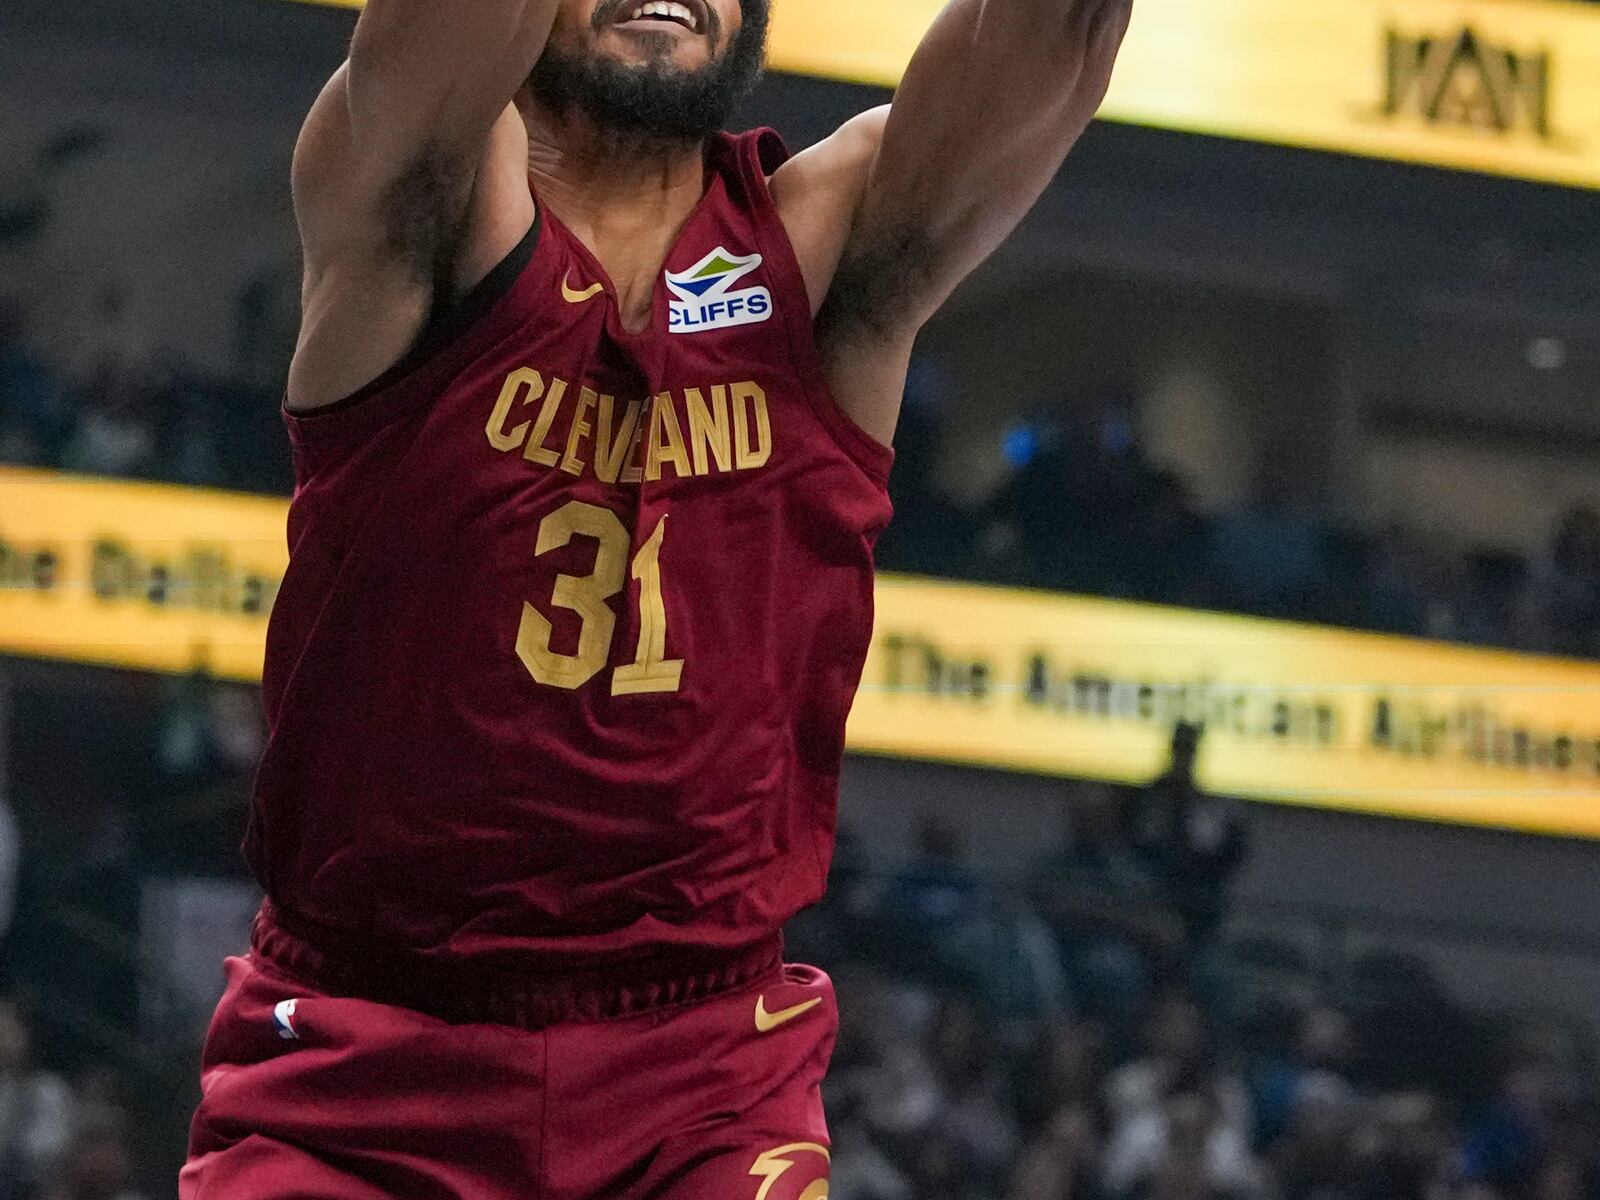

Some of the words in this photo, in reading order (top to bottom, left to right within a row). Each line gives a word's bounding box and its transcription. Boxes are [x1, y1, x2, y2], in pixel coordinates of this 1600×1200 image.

[669, 294, 768, 325] CLIFFS
[485, 366, 772, 485] CLEVELAND
[90, 535, 281, 615] Dalla
[515, 500, 685, 696] 31
[880, 633, 990, 700] The
[1022, 650, 1336, 743] American
